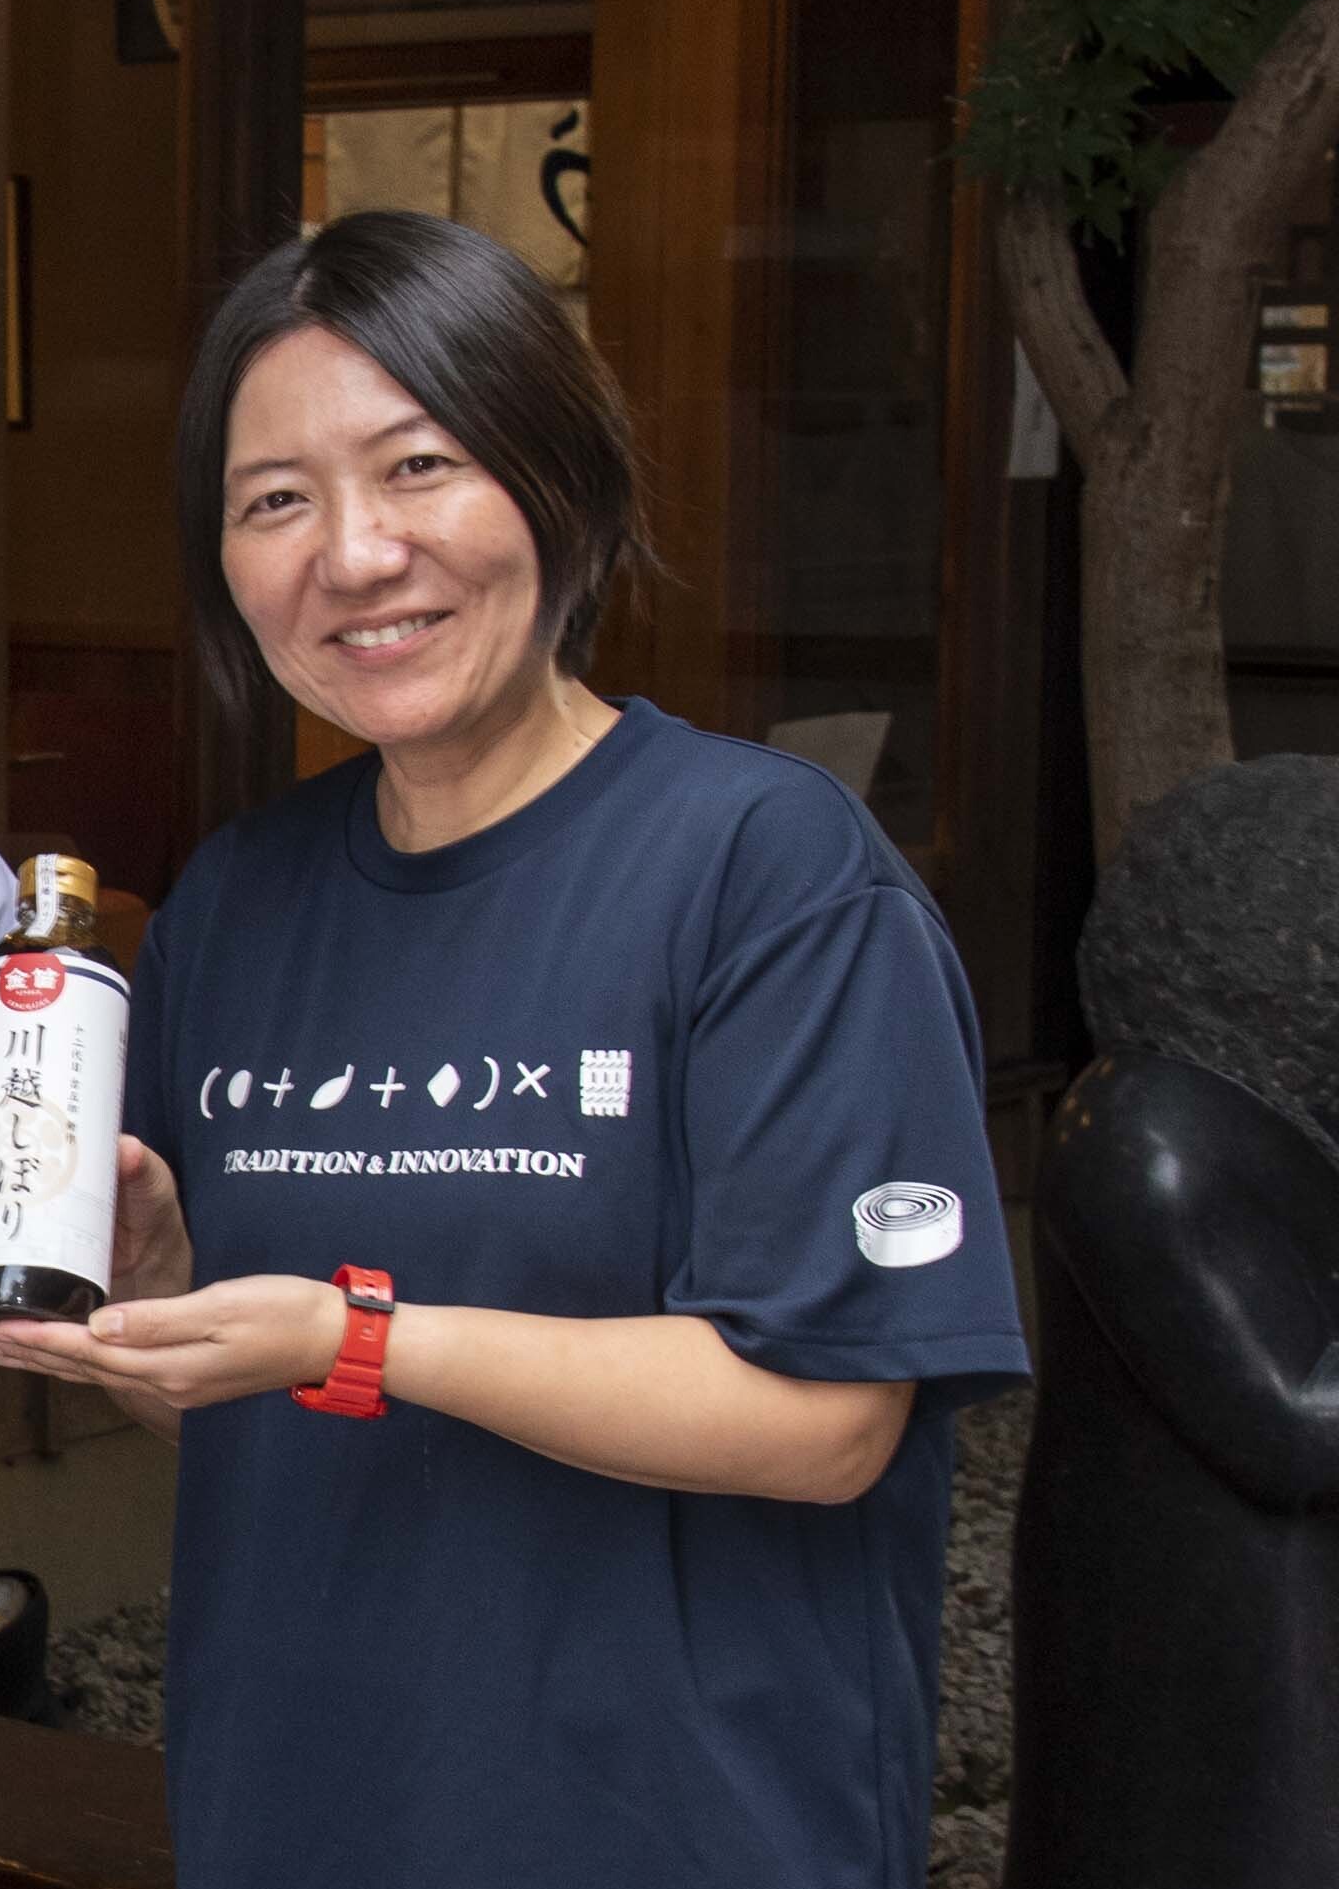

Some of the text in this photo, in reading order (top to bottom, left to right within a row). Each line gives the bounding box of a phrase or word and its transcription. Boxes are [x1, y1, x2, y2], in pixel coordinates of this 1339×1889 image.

[225, 1148, 586, 1178] TRADITION & INNOVATION
